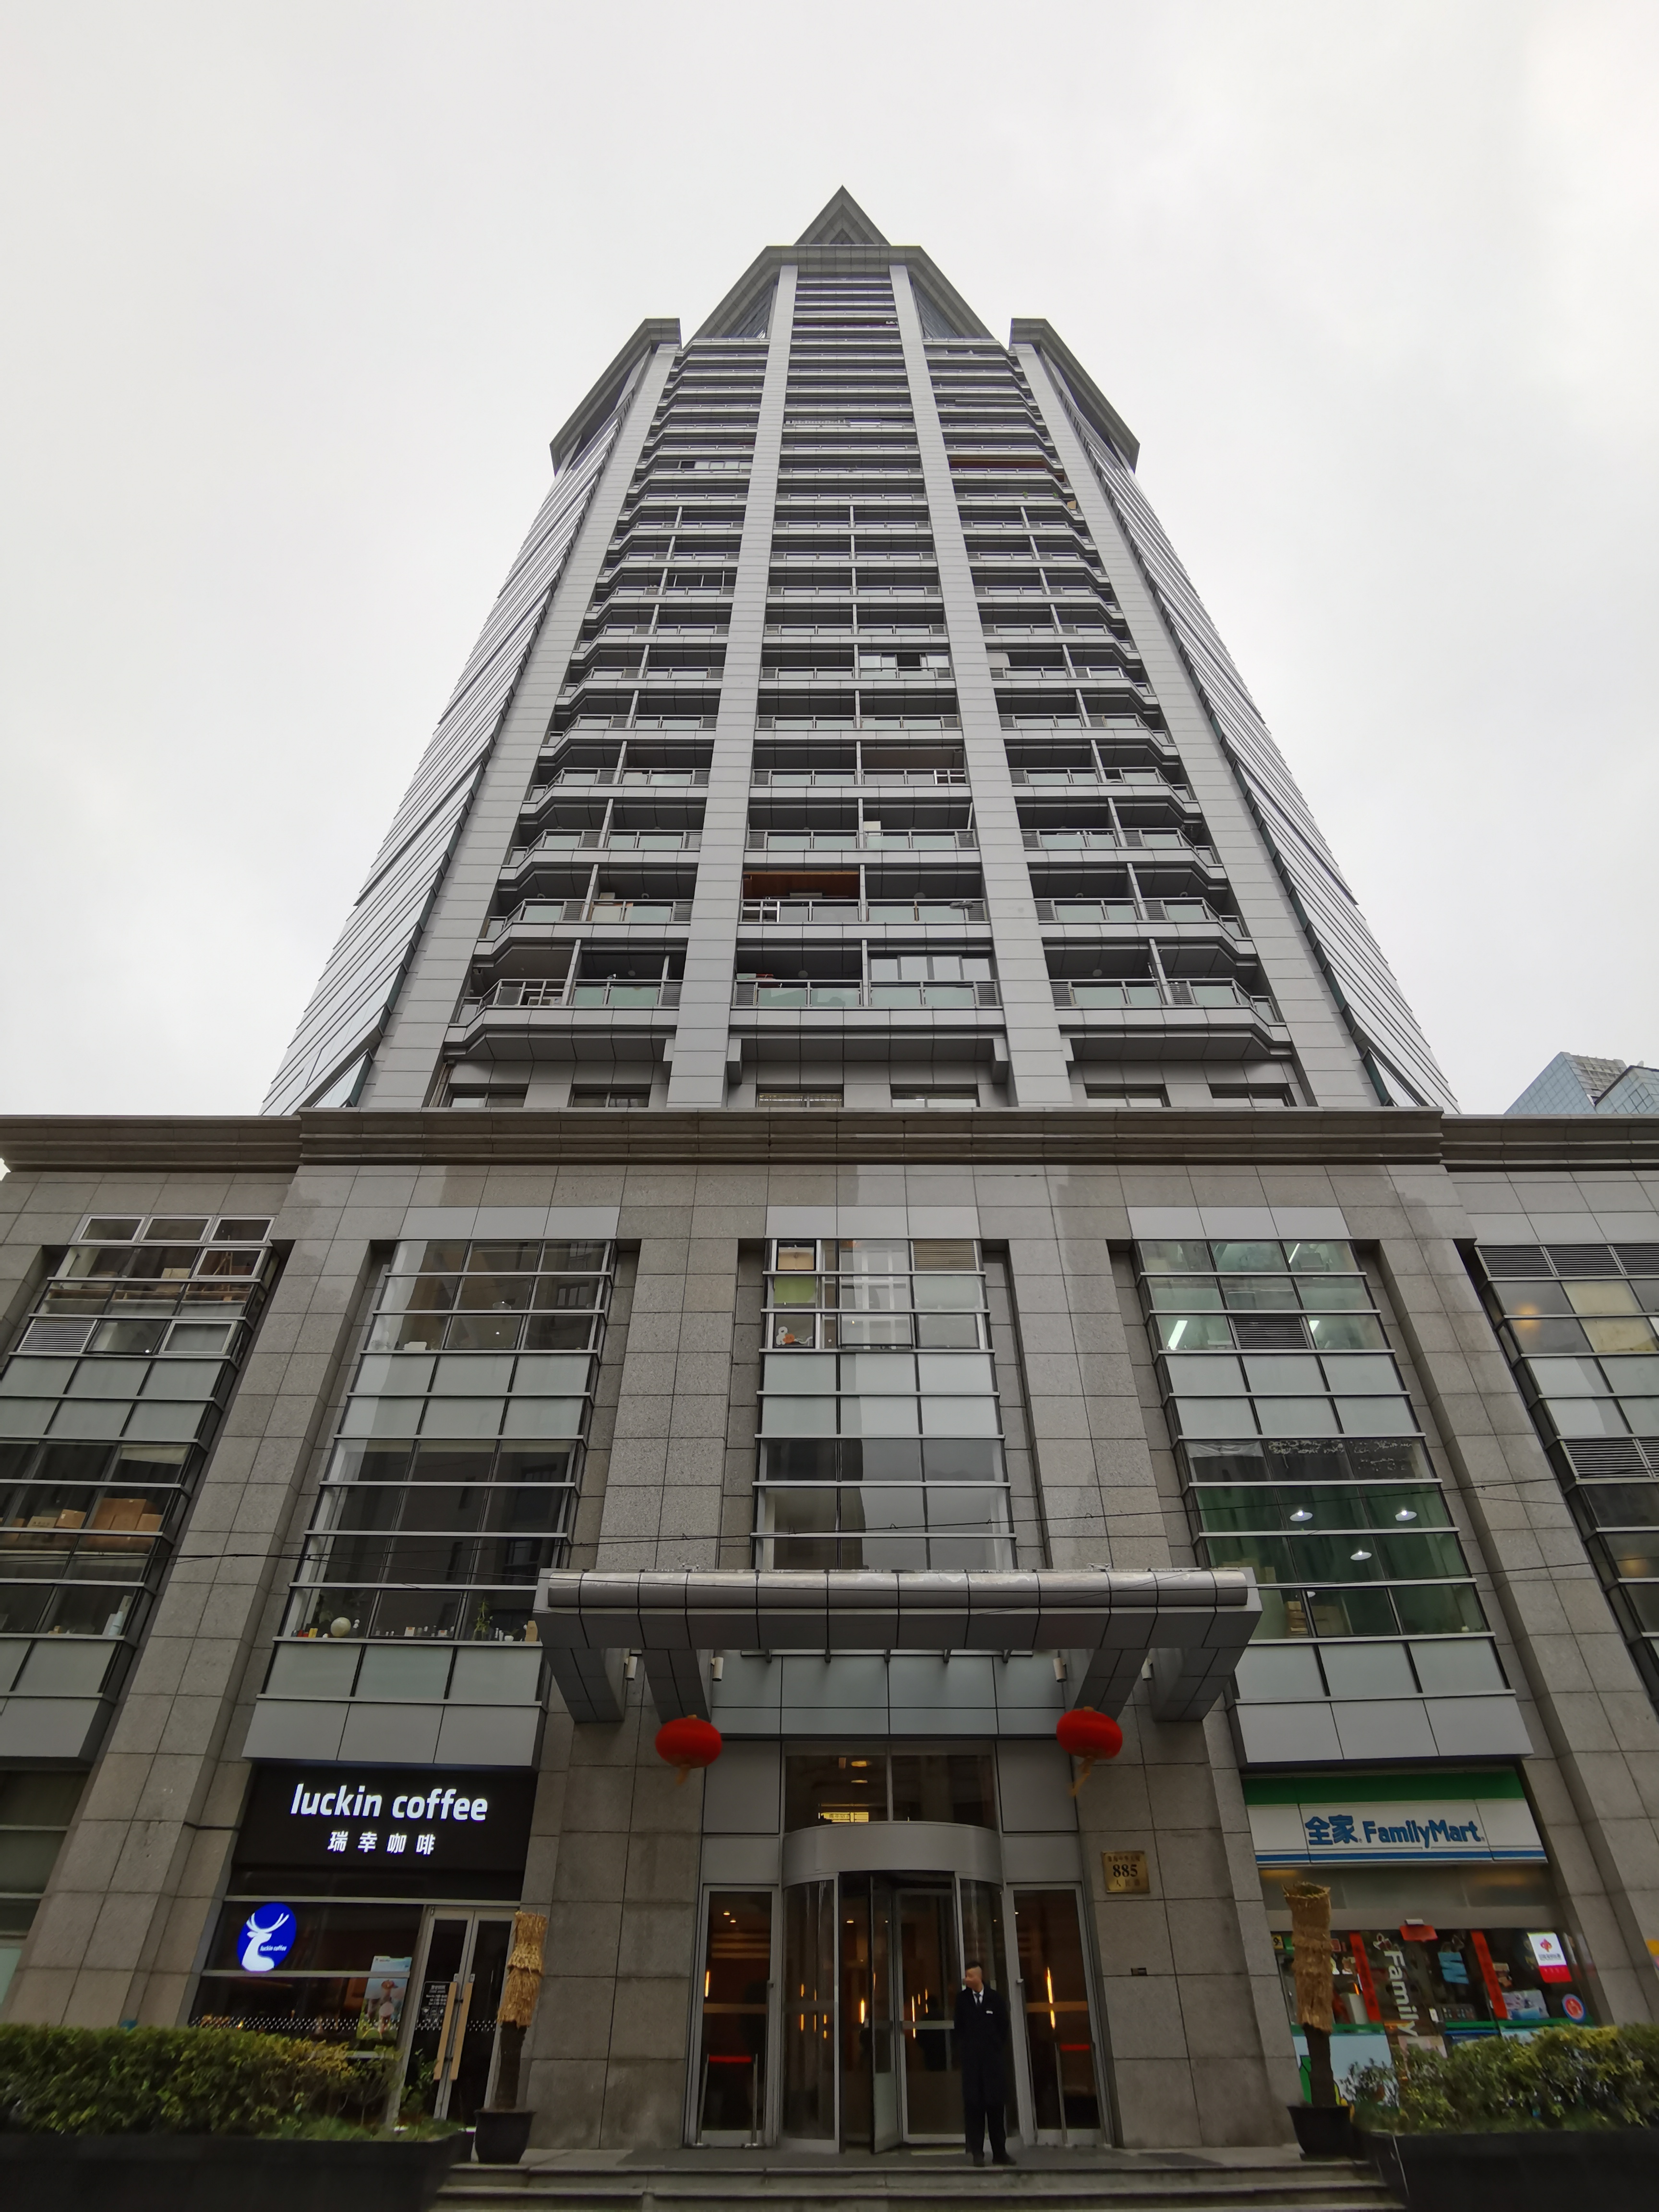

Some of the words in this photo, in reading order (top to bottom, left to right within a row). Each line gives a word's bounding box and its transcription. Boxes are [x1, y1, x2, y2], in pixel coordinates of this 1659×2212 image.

[290, 1783, 383, 1817] luckin
[392, 1788, 488, 1821] coffee
[327, 1830, 436, 1855] 瑞幸咖啡
[1305, 1815, 1358, 1845] 全家
[1362, 1819, 1482, 1849] FamilyMart
[1113, 1863, 1138, 1877] 885
[1384, 1950, 1419, 2037] Family
